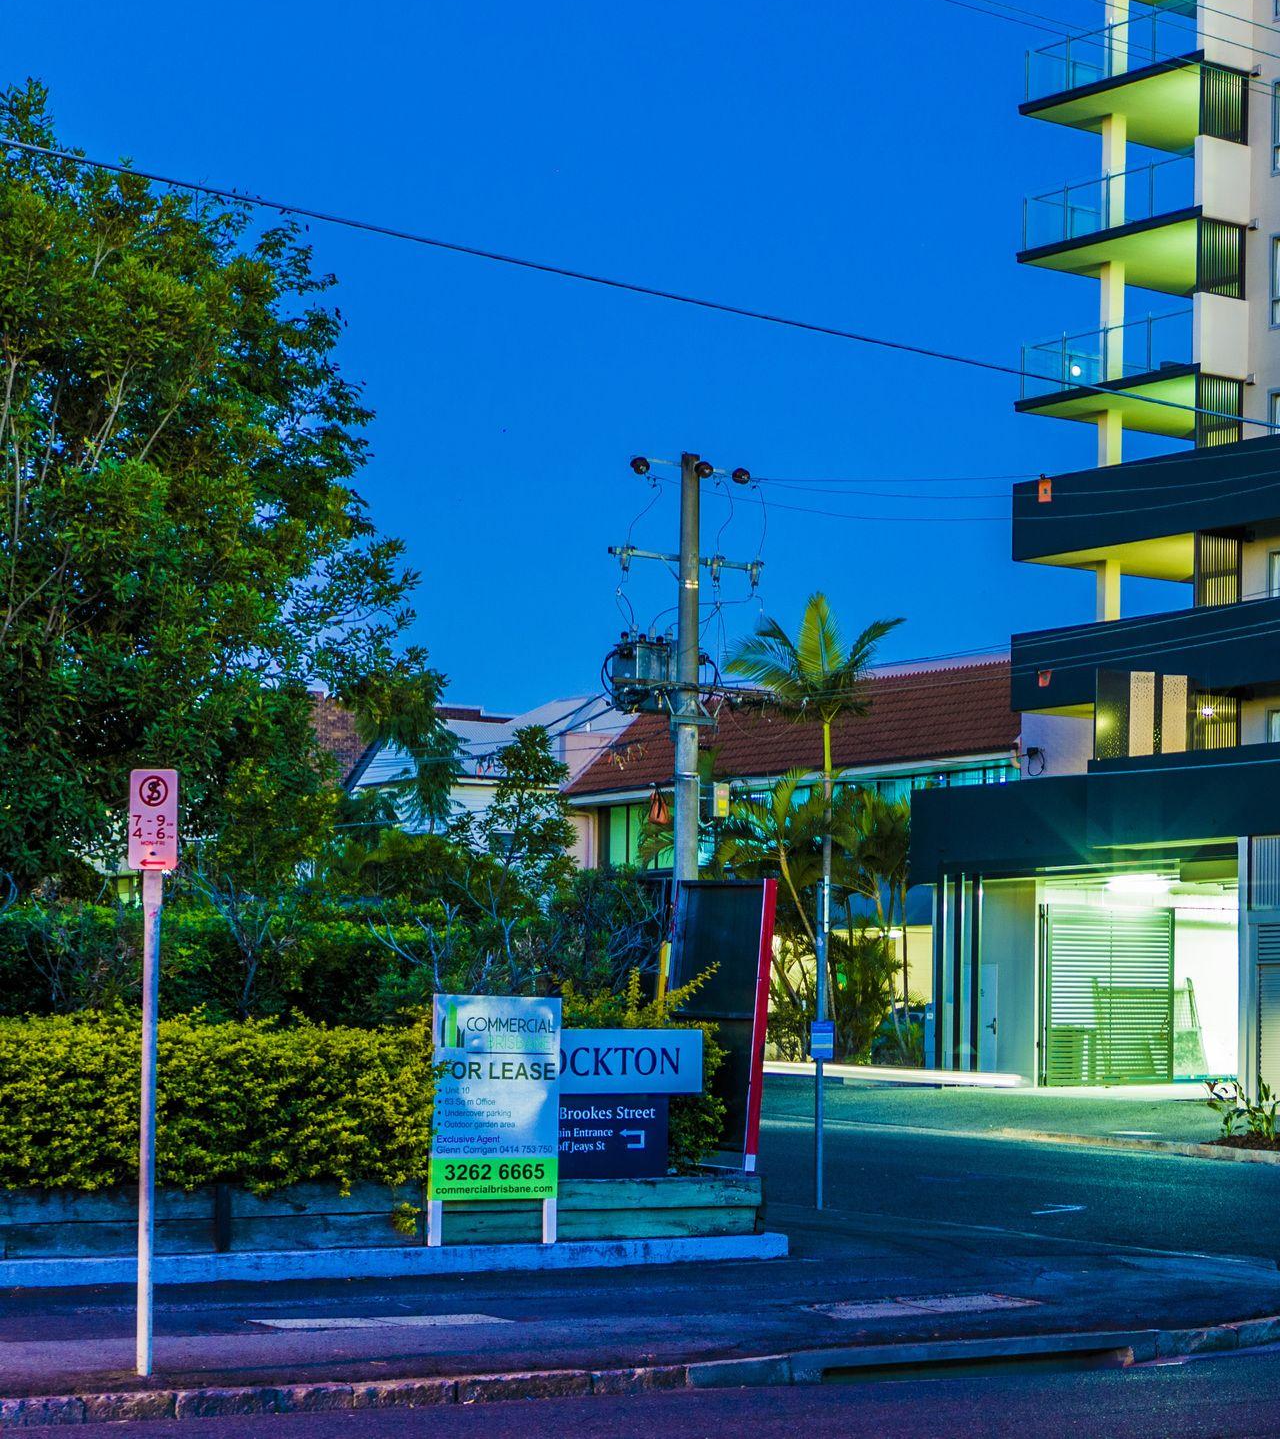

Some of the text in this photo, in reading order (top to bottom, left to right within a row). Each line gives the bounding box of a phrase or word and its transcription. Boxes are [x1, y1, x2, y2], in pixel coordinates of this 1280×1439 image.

[466, 1017, 556, 1034] COMMERCIAL
[487, 1034, 553, 1050] BRISBANE
[489, 1062, 556, 1080] LEASE
[476, 1098, 496, 1106] Office
[486, 1110, 512, 1118] parking
[559, 1106, 656, 1120] Brookes Street
[444, 1121, 473, 1129] Outdoor
[474, 1121, 499, 1130] garden
[573, 1127, 614, 1138] Entrance
[436, 1135, 501, 1145] Exclusive Agent
[436, 1145, 553, 1155] Glenn Corrigan 0414 753 750
[570, 1141, 594, 1154] Jeays
[596, 1140, 606, 1151] St
[444, 1163, 545, 1181] 3262 6665
[435, 1185, 553, 1194] commercialbrisbane.com
